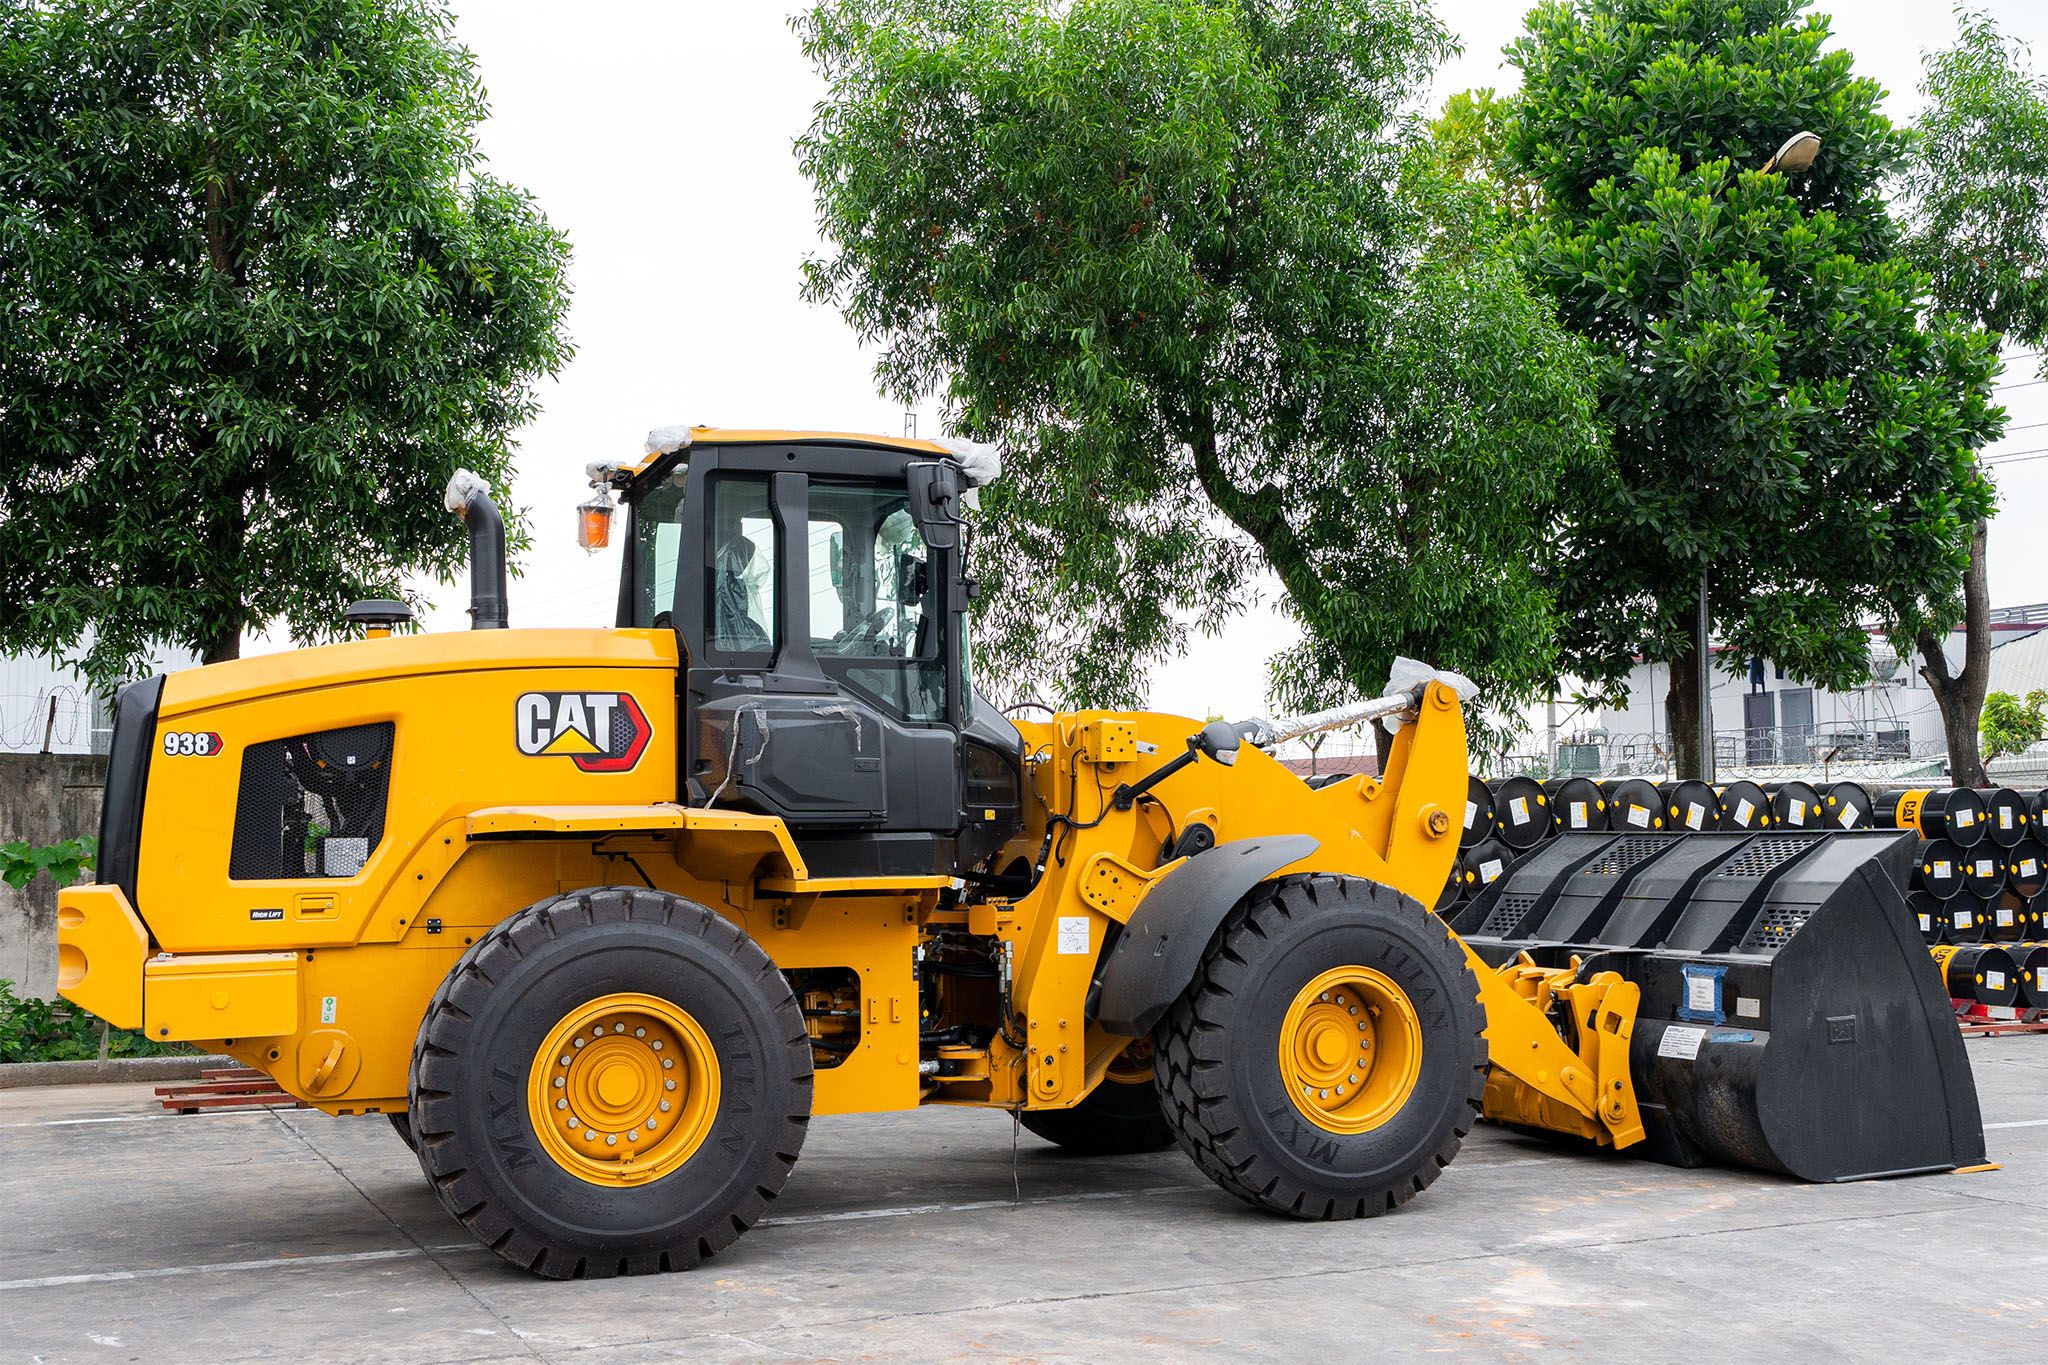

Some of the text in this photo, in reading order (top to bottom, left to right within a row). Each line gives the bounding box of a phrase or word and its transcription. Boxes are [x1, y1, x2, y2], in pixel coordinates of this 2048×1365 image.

[517, 693, 618, 754] CAT
[164, 732, 210, 756] 938
[1902, 800, 1917, 824] CAT
[251, 910, 283, 919] HIGH LIFT
[1376, 940, 1448, 1031] TITAN
[1830, 1020, 1853, 1042] CAT
